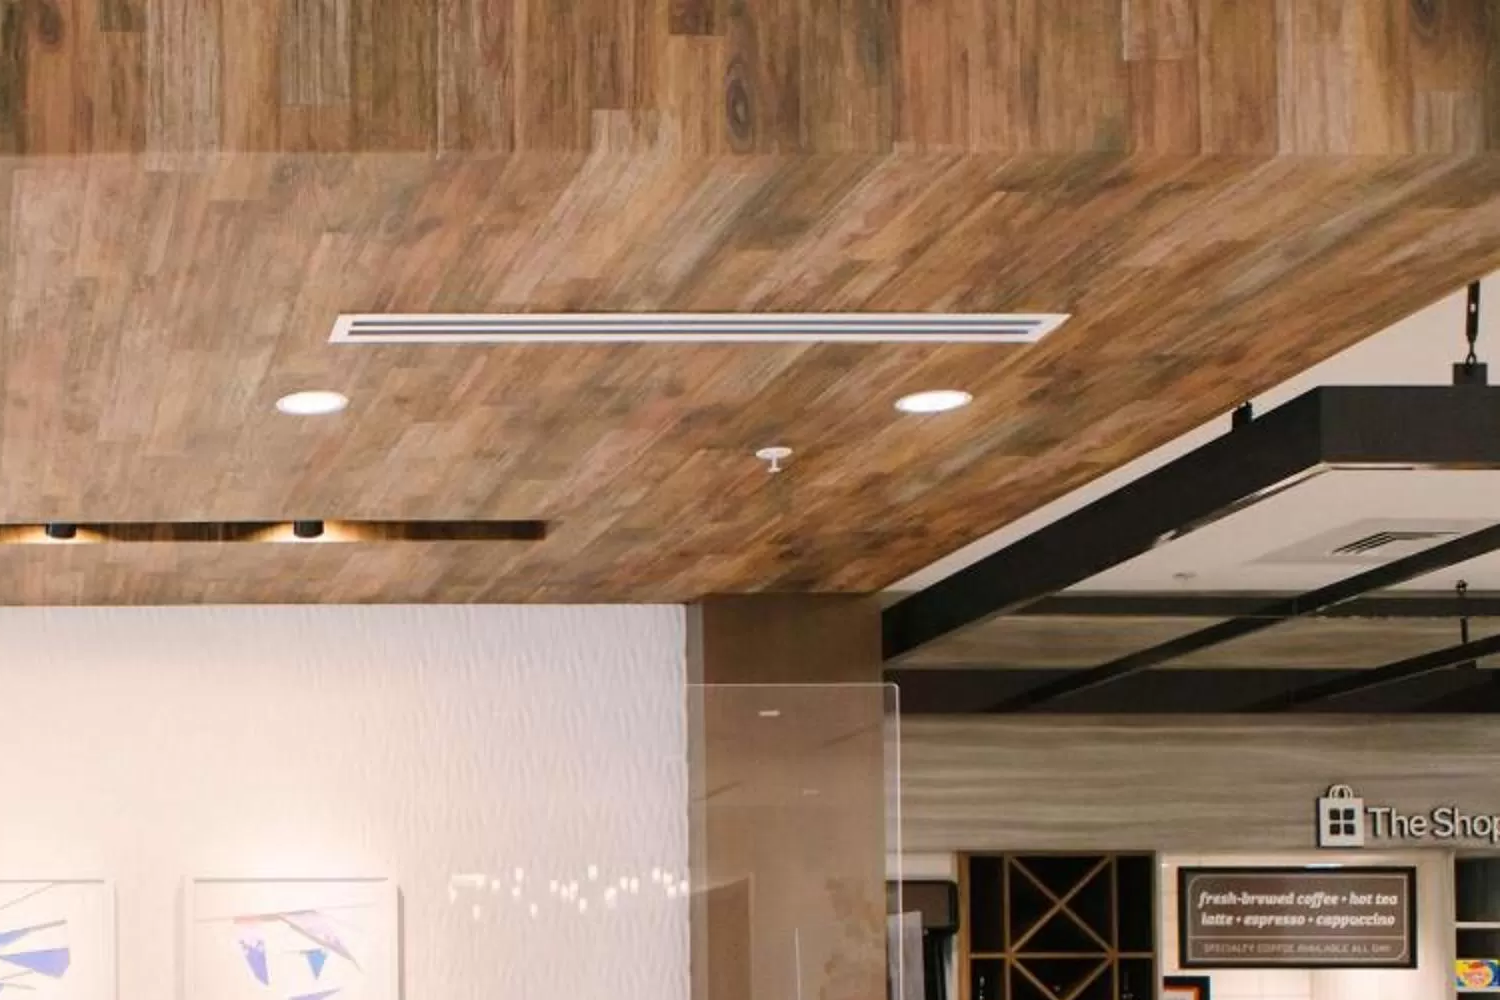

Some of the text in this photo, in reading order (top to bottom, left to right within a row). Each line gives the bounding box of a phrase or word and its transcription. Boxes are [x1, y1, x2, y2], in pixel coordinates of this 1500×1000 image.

[1367, 807, 1427, 836] The
[1197, 891, 1398, 908] fresh-brewed coffee hot tea
[1201, 912, 1395, 928] latte espresso cappuccino
